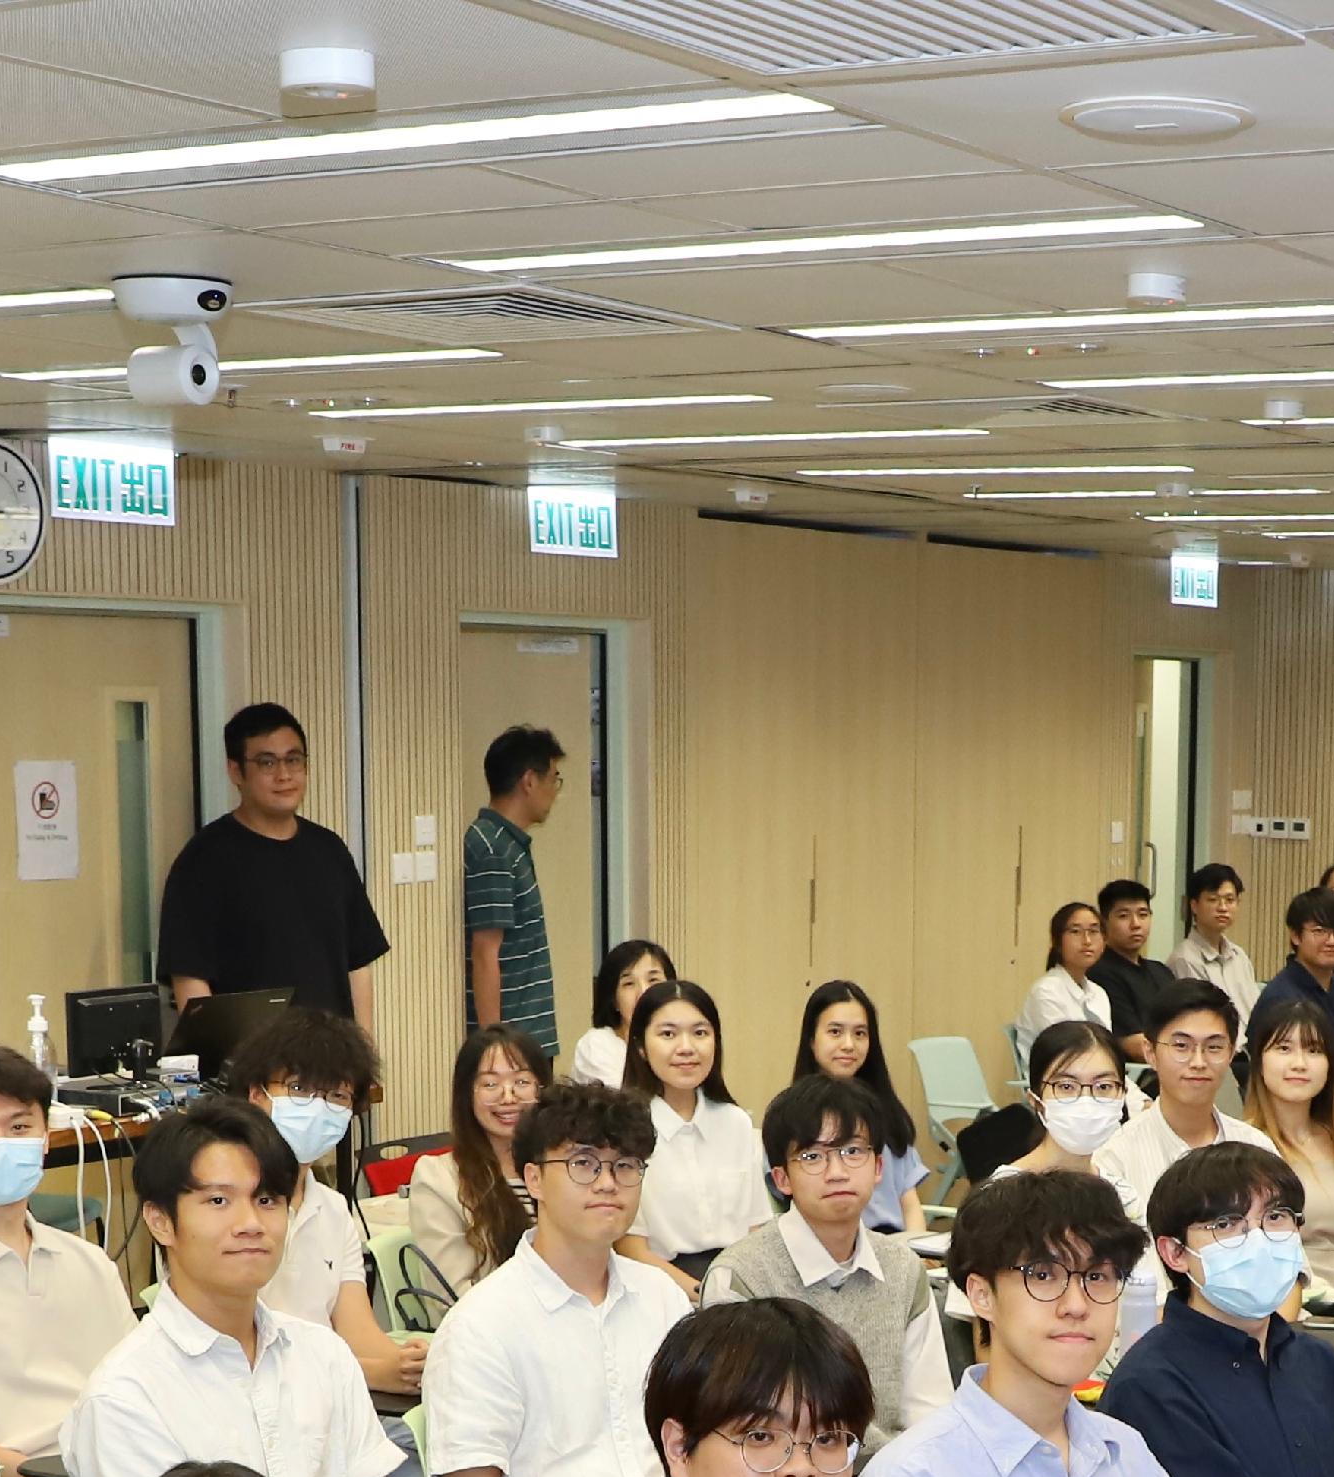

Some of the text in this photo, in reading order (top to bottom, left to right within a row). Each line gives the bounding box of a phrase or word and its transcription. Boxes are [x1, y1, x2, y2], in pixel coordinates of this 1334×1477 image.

[3, 461, 8, 473] 1
[17, 480, 26, 493] 2
[56, 455, 169, 516] EXIT 出口
[534, 500, 612, 549] EXIT 出口
[6, 551, 15, 563] 5
